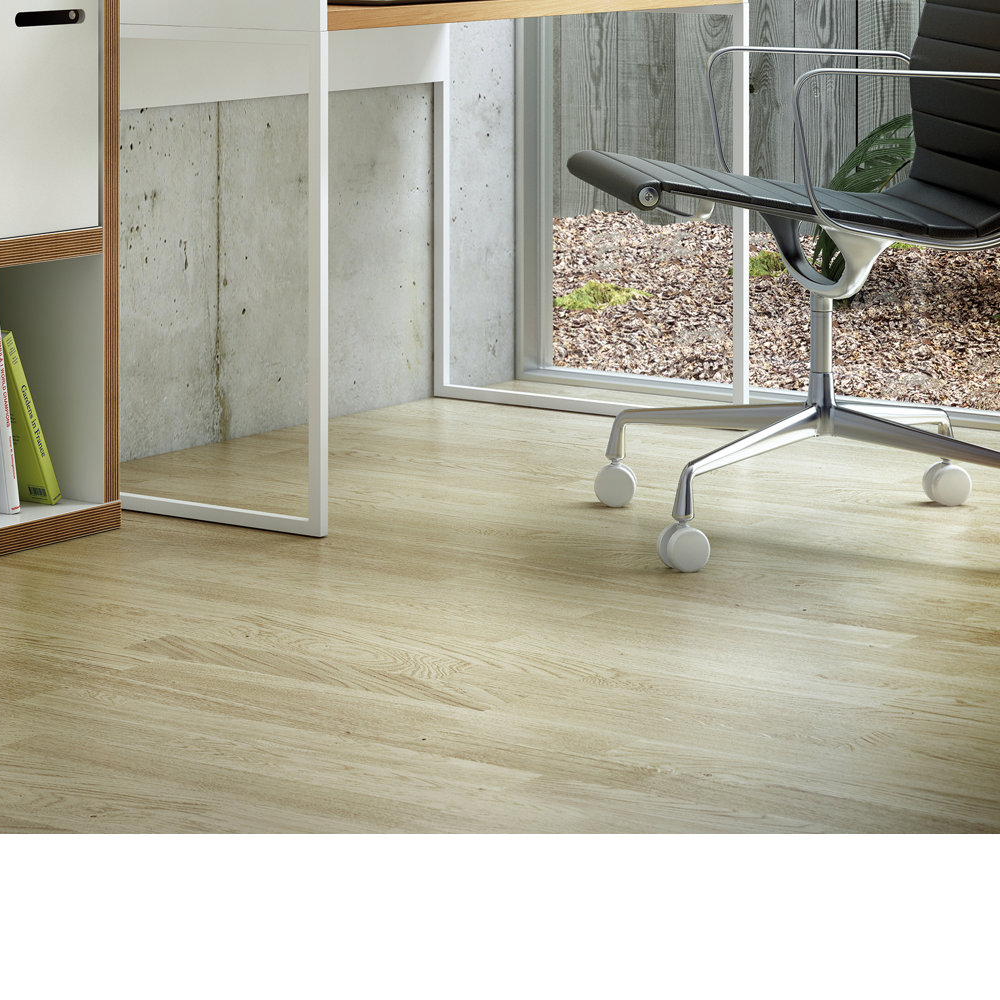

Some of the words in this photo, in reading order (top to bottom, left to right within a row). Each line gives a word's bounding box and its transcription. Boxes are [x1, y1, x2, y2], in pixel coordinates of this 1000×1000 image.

[3, 392, 11, 428] CHAMPIONS
[21, 385, 35, 419] Gardens
[31, 420, 38, 429] in
[34, 429, 46, 458] France
